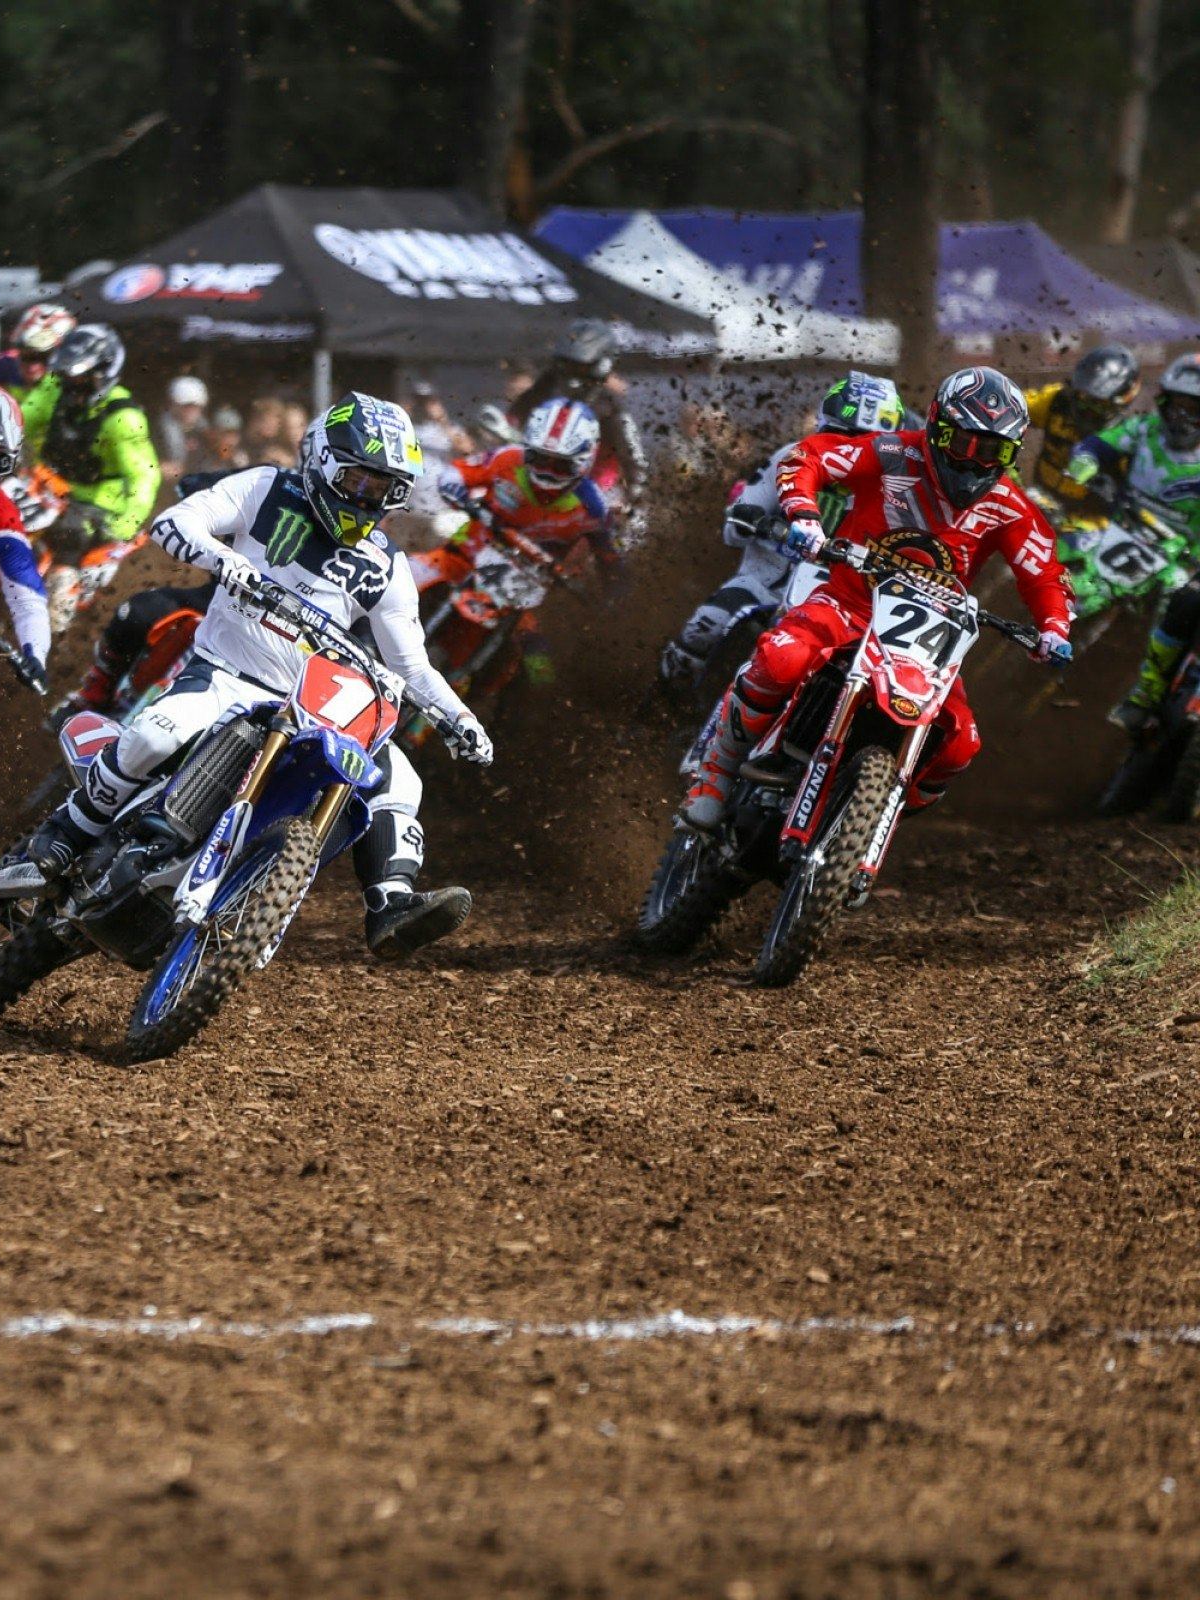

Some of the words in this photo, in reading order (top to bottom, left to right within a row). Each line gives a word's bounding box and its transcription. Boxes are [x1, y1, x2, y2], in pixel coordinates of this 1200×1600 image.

[295, 581, 316, 598] FOX
[879, 603, 963, 671] 24
[316, 674, 377, 730] 1
[73, 723, 121, 747] 1
[149, 713, 177, 734] FOX
[198, 816, 231, 876] DUNLOP
